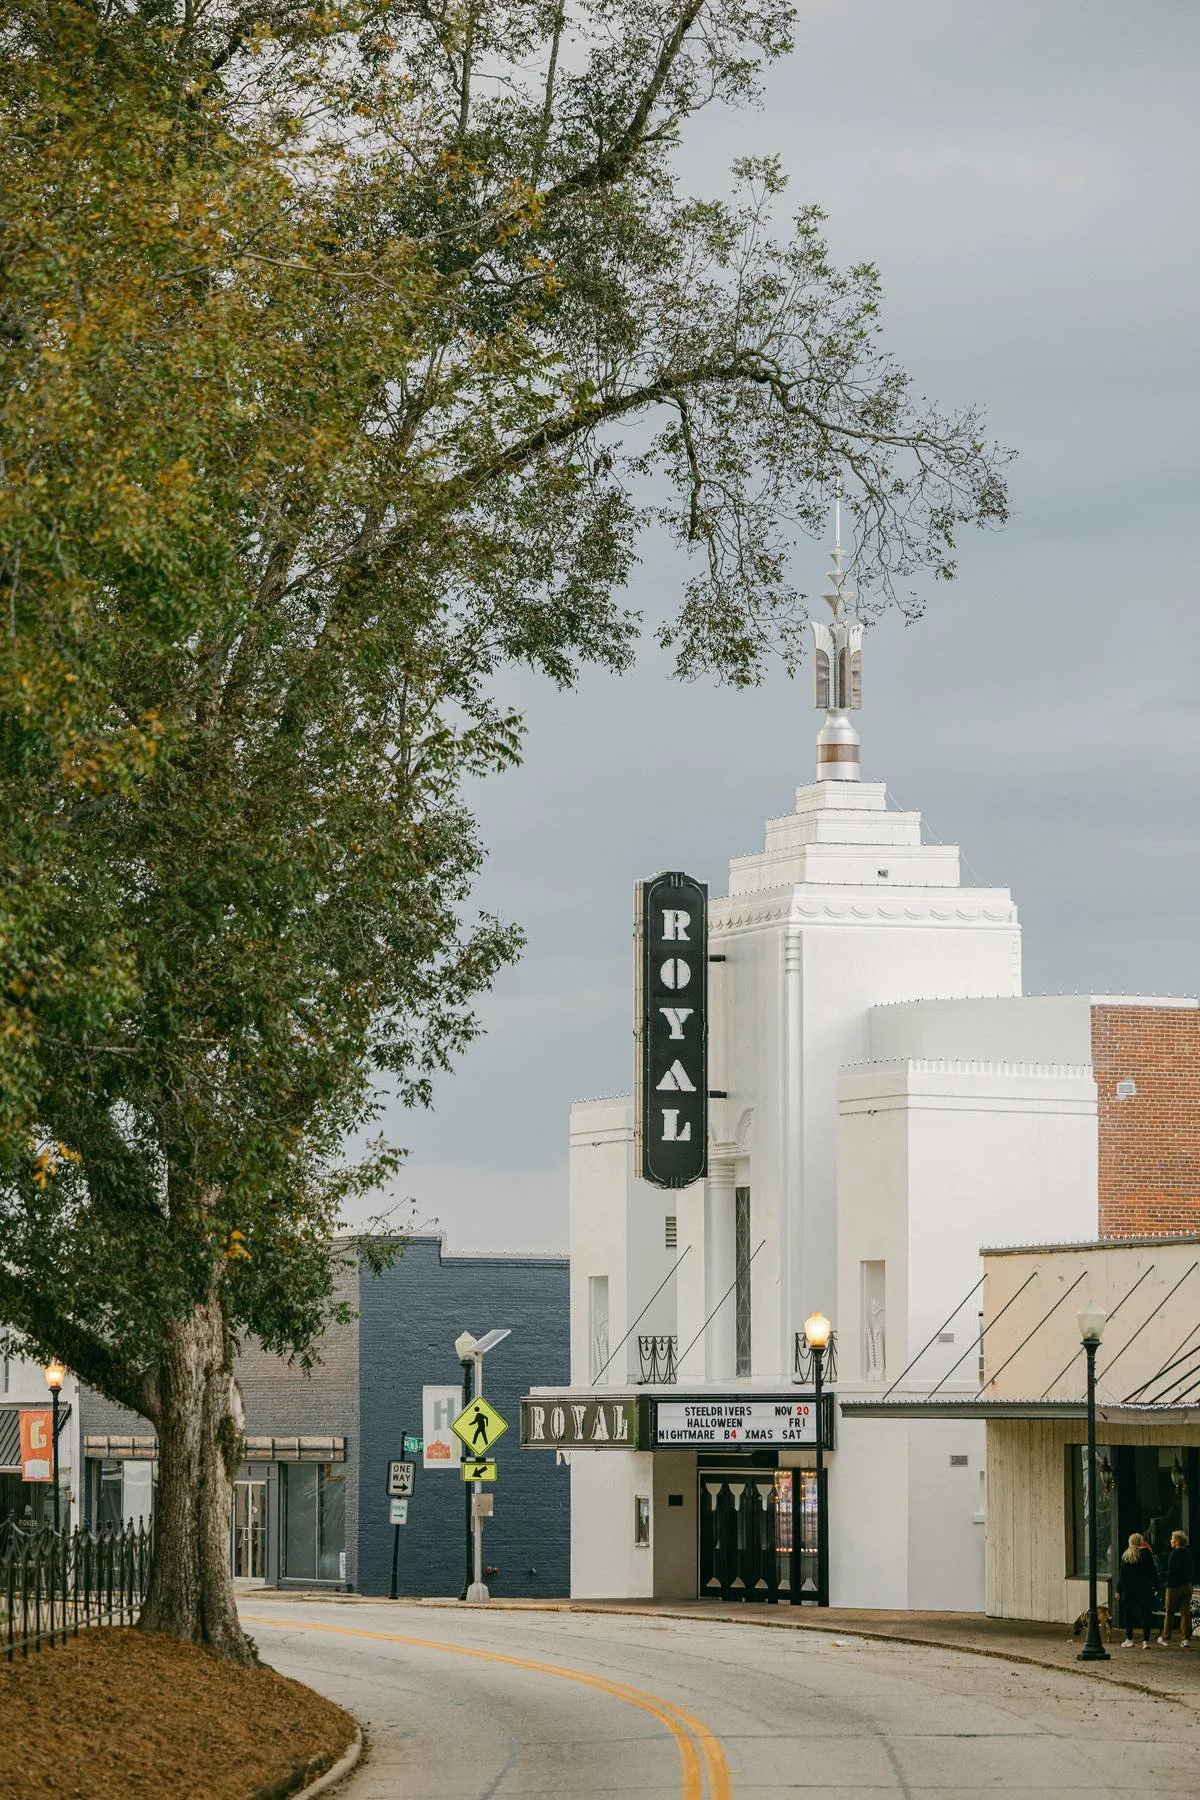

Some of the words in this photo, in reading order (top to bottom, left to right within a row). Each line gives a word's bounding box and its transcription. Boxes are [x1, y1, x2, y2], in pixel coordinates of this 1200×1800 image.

[656, 909, 697, 1141] ROYAL
[684, 1406, 752, 1416] STEELDRIVERS
[775, 1406, 792, 1416] NOV
[796, 1406, 809, 1415] 20
[530, 1405, 628, 1440] ROYAL
[687, 1418, 743, 1427] HALLOWEEN
[789, 1418, 806, 1427] FRI
[31, 1420, 46, 1449] G
[658, 1430, 715, 1439] NIGHTMARE
[724, 1430, 737, 1439] B4
[745, 1430, 773, 1439] XMAS
[782, 1430, 802, 1439] SAT
[393, 1464, 411, 1473] ONE
[392, 1474, 411, 1482] WAY
